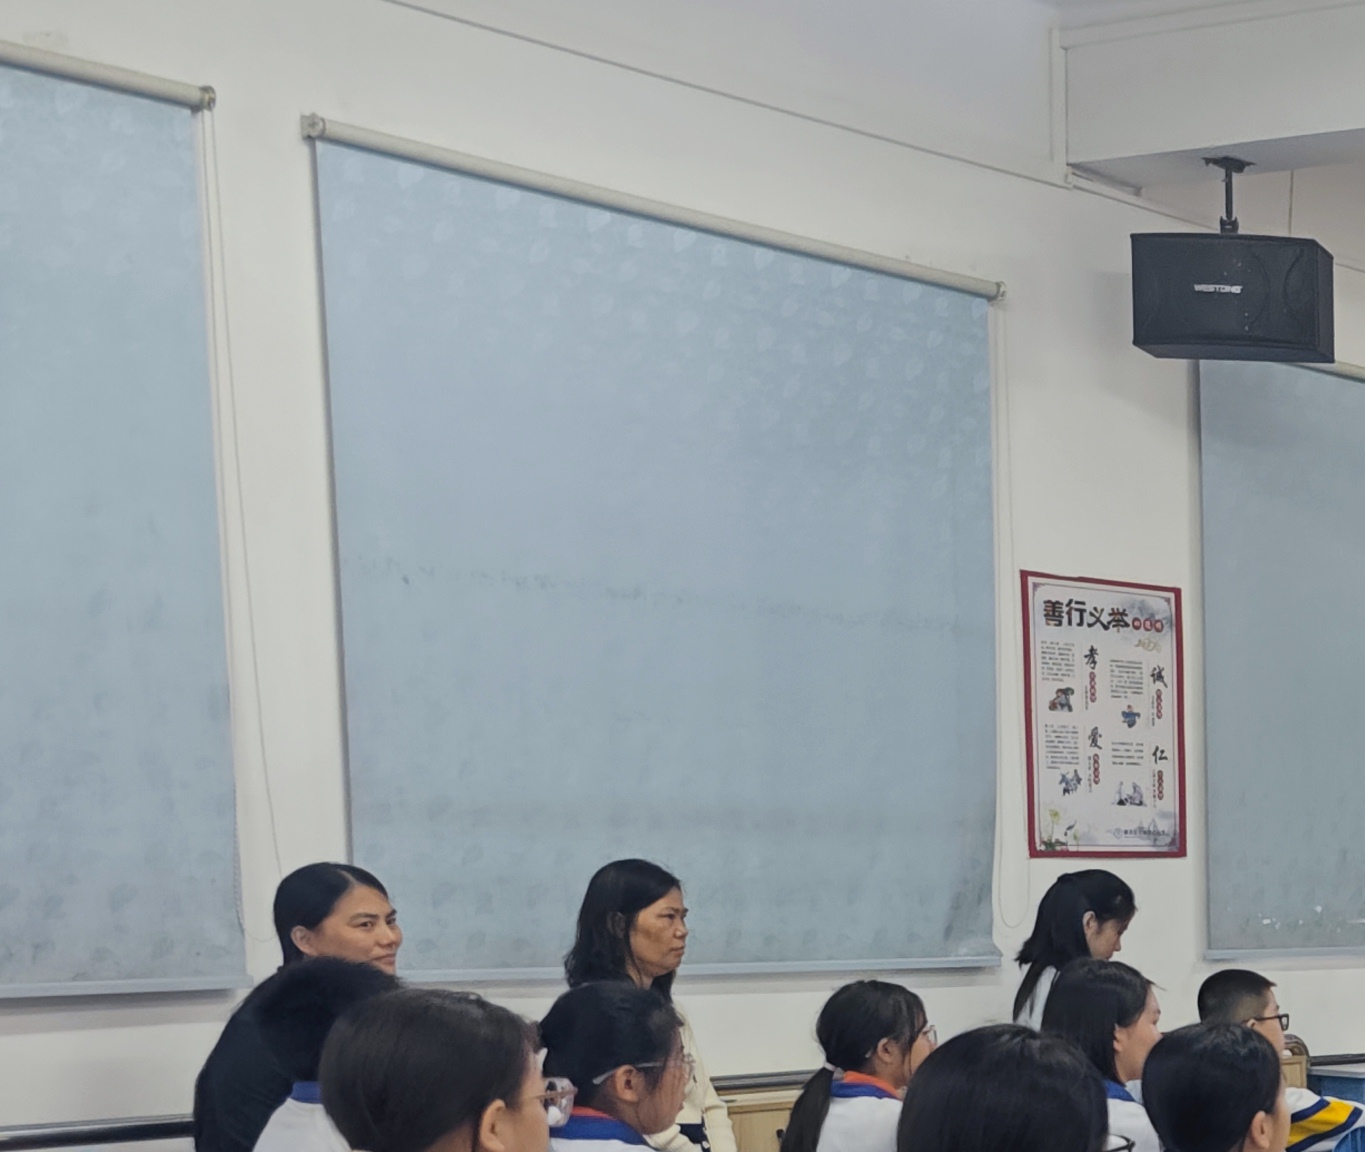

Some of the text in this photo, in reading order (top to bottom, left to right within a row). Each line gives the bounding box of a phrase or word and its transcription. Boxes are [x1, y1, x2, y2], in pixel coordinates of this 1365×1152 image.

[1043, 598, 1131, 633] 善行义举
[1152, 745, 1168, 765] 仁
